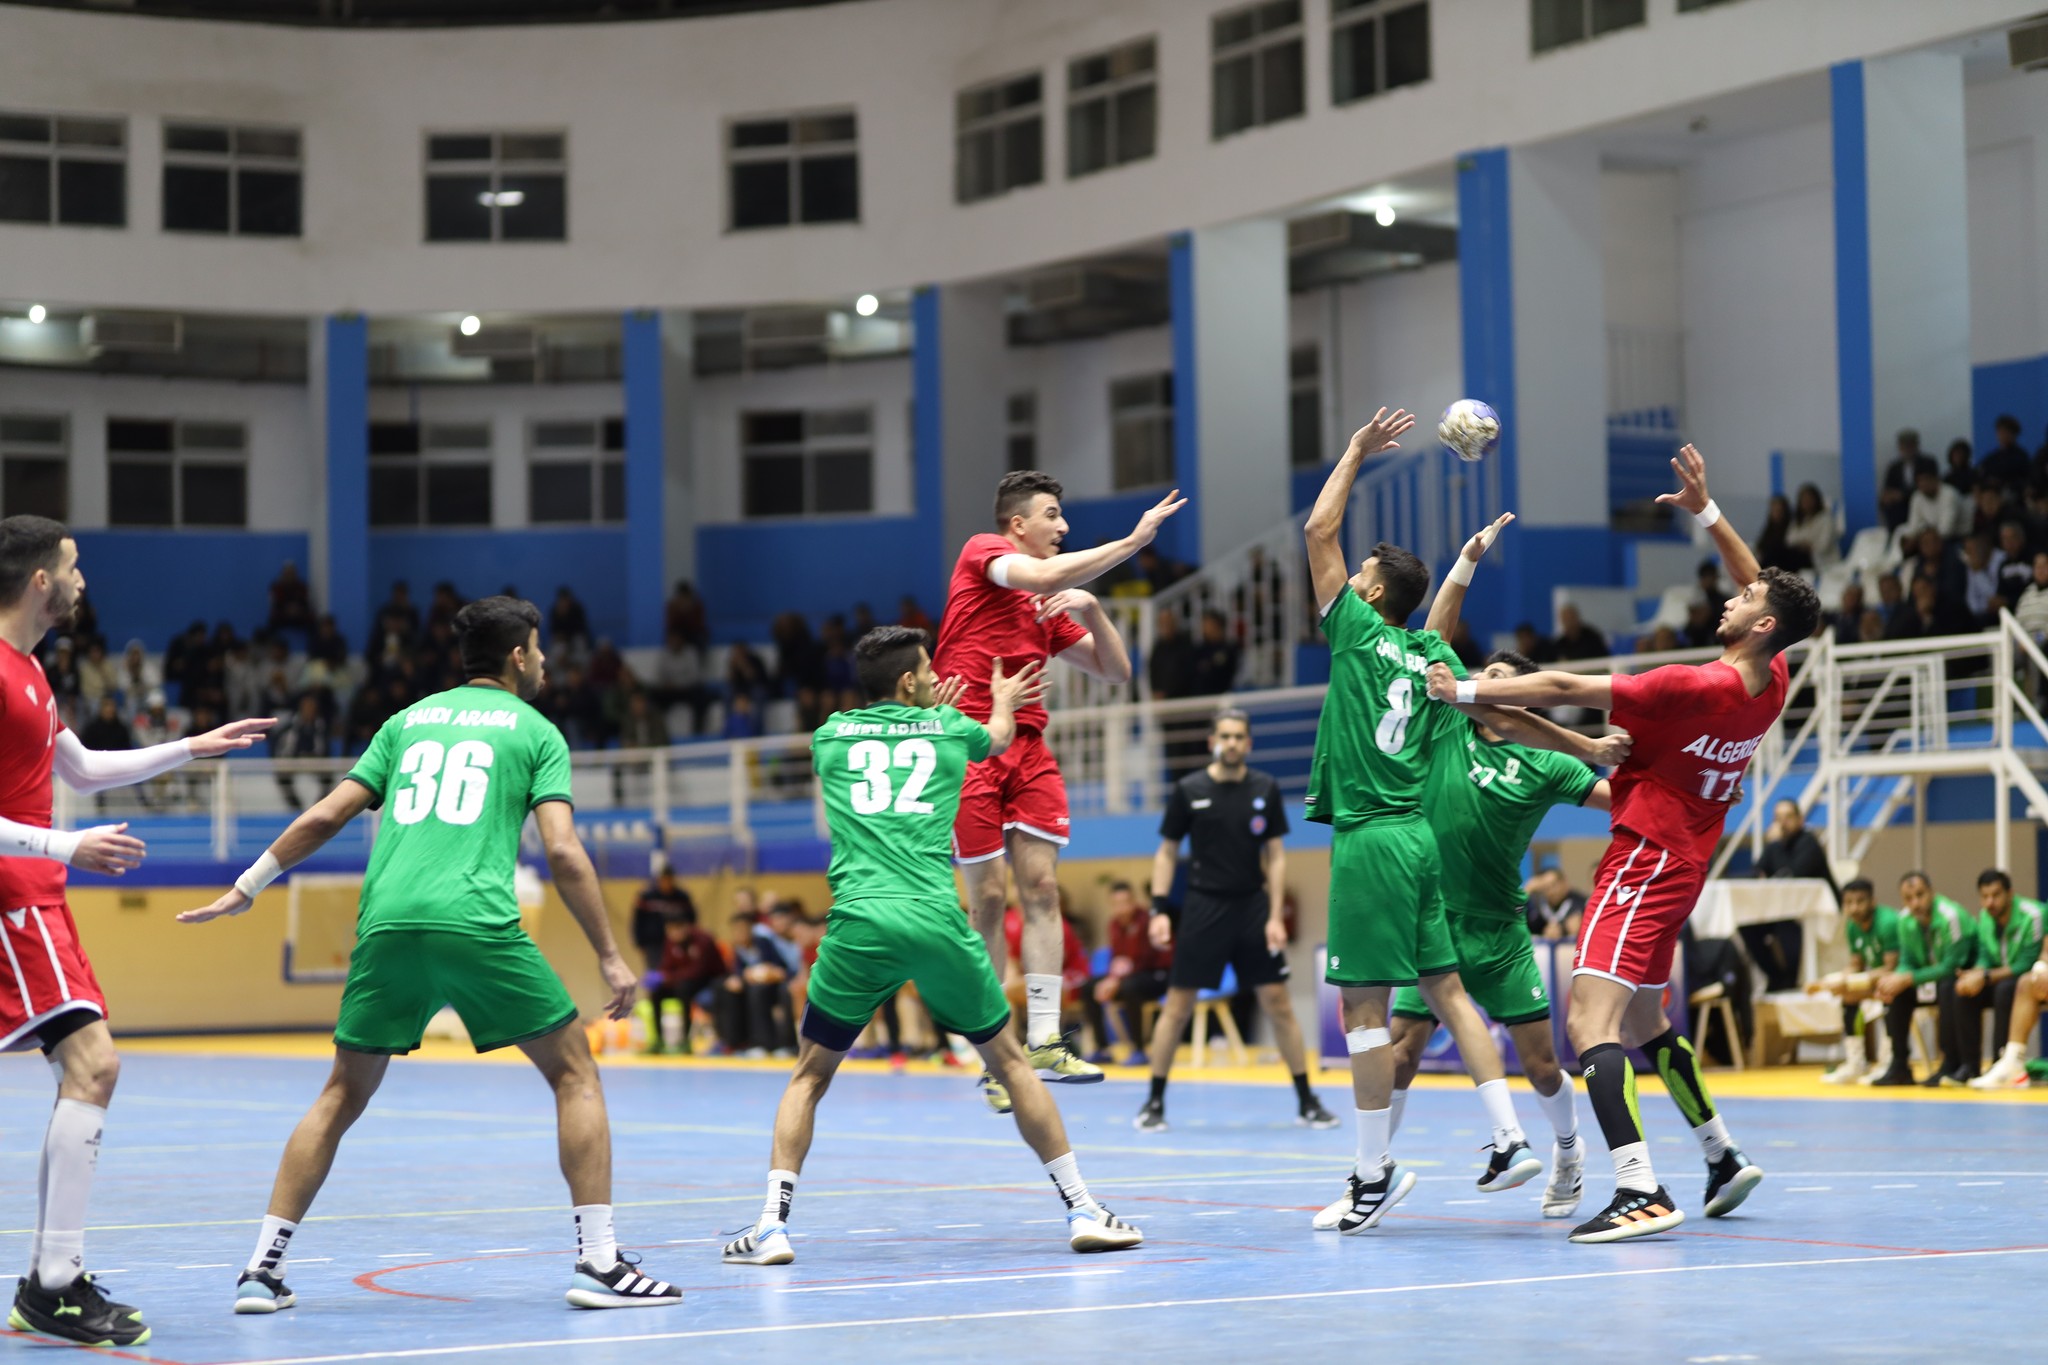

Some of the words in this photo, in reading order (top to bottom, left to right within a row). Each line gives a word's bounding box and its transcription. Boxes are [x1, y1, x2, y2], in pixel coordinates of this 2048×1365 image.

[403, 706, 453, 730] SAUDI
[451, 709, 518, 731] ARABIA
[1375, 678, 1412, 755] 8
[848, 738, 937, 815] 32
[1680, 733, 1764, 764] ALGERIE
[393, 739, 494, 825] 36
[1697, 767, 1742, 802] 17
